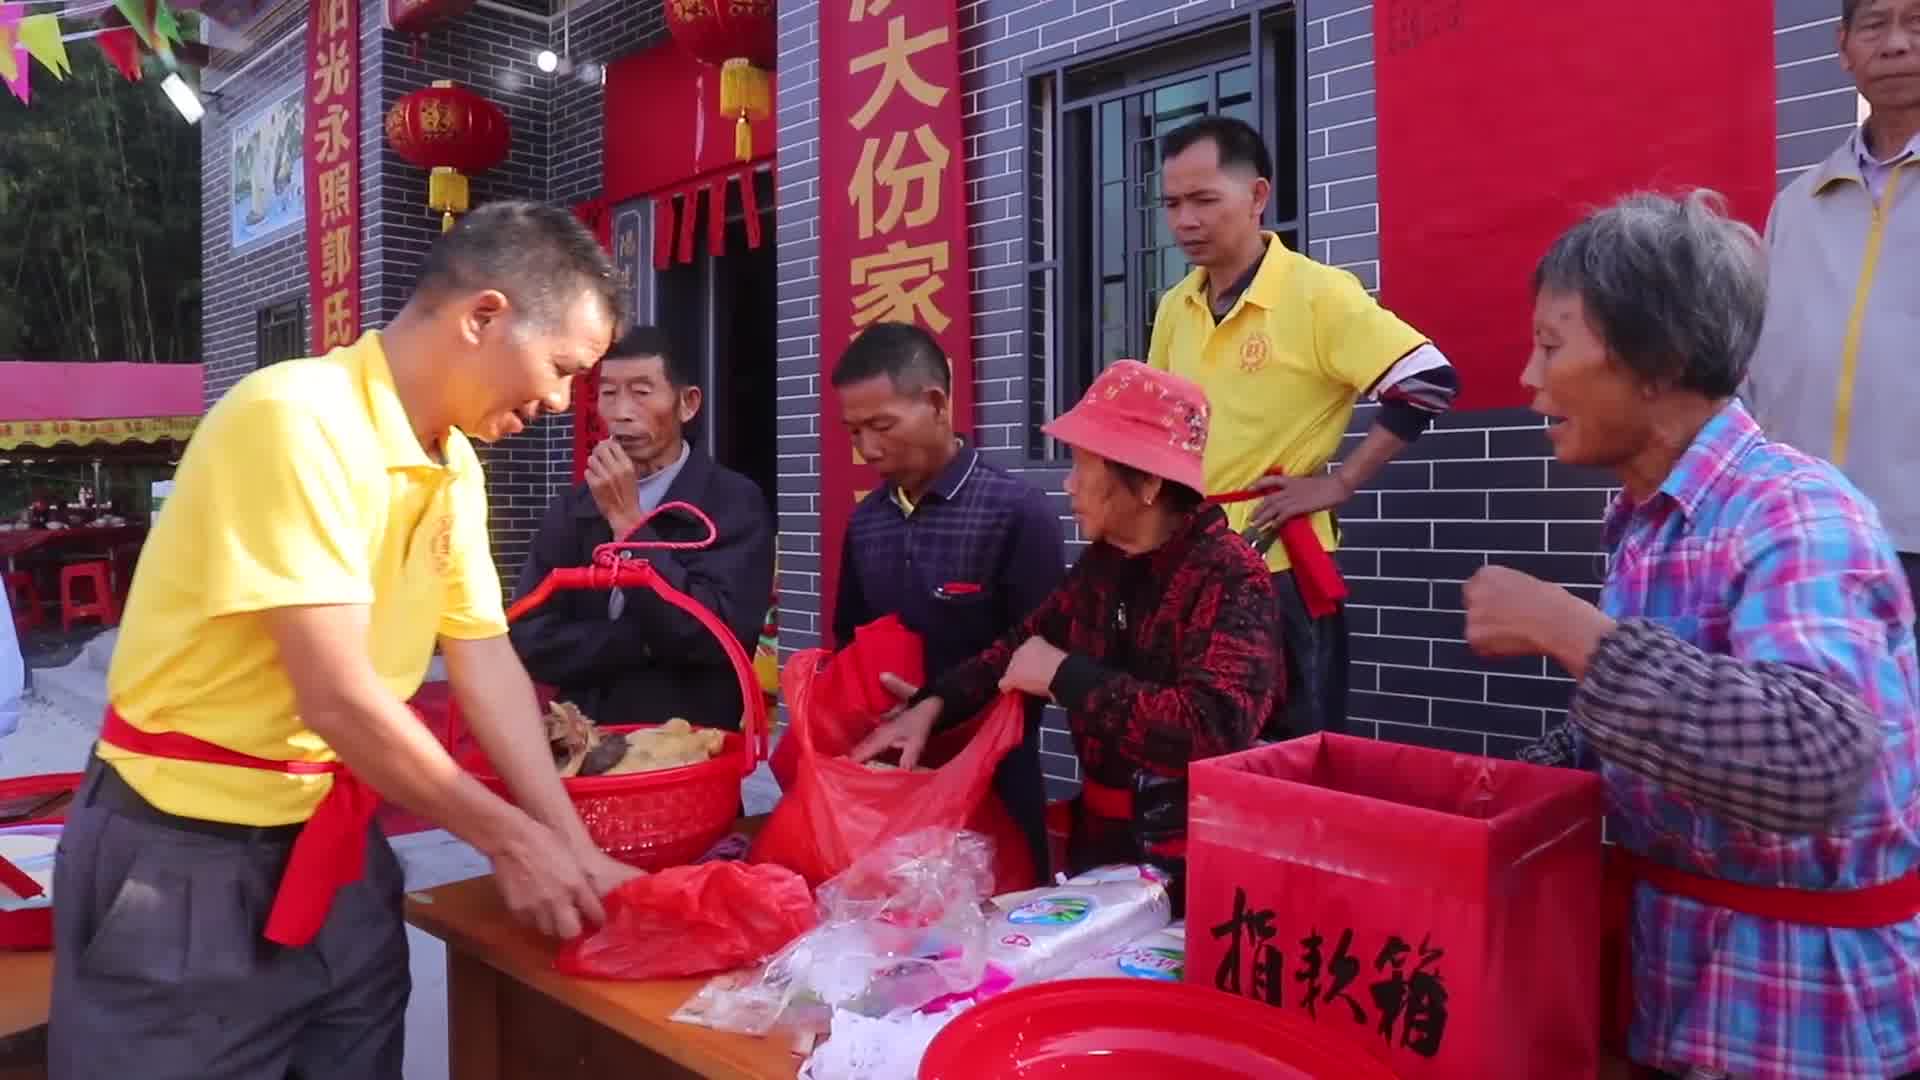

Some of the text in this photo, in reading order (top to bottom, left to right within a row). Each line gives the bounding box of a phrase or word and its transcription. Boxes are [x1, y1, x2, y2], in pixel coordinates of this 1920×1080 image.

[848, 0, 953, 465] 大份家
[1210, 886, 1449, 1058] 捐款箱
